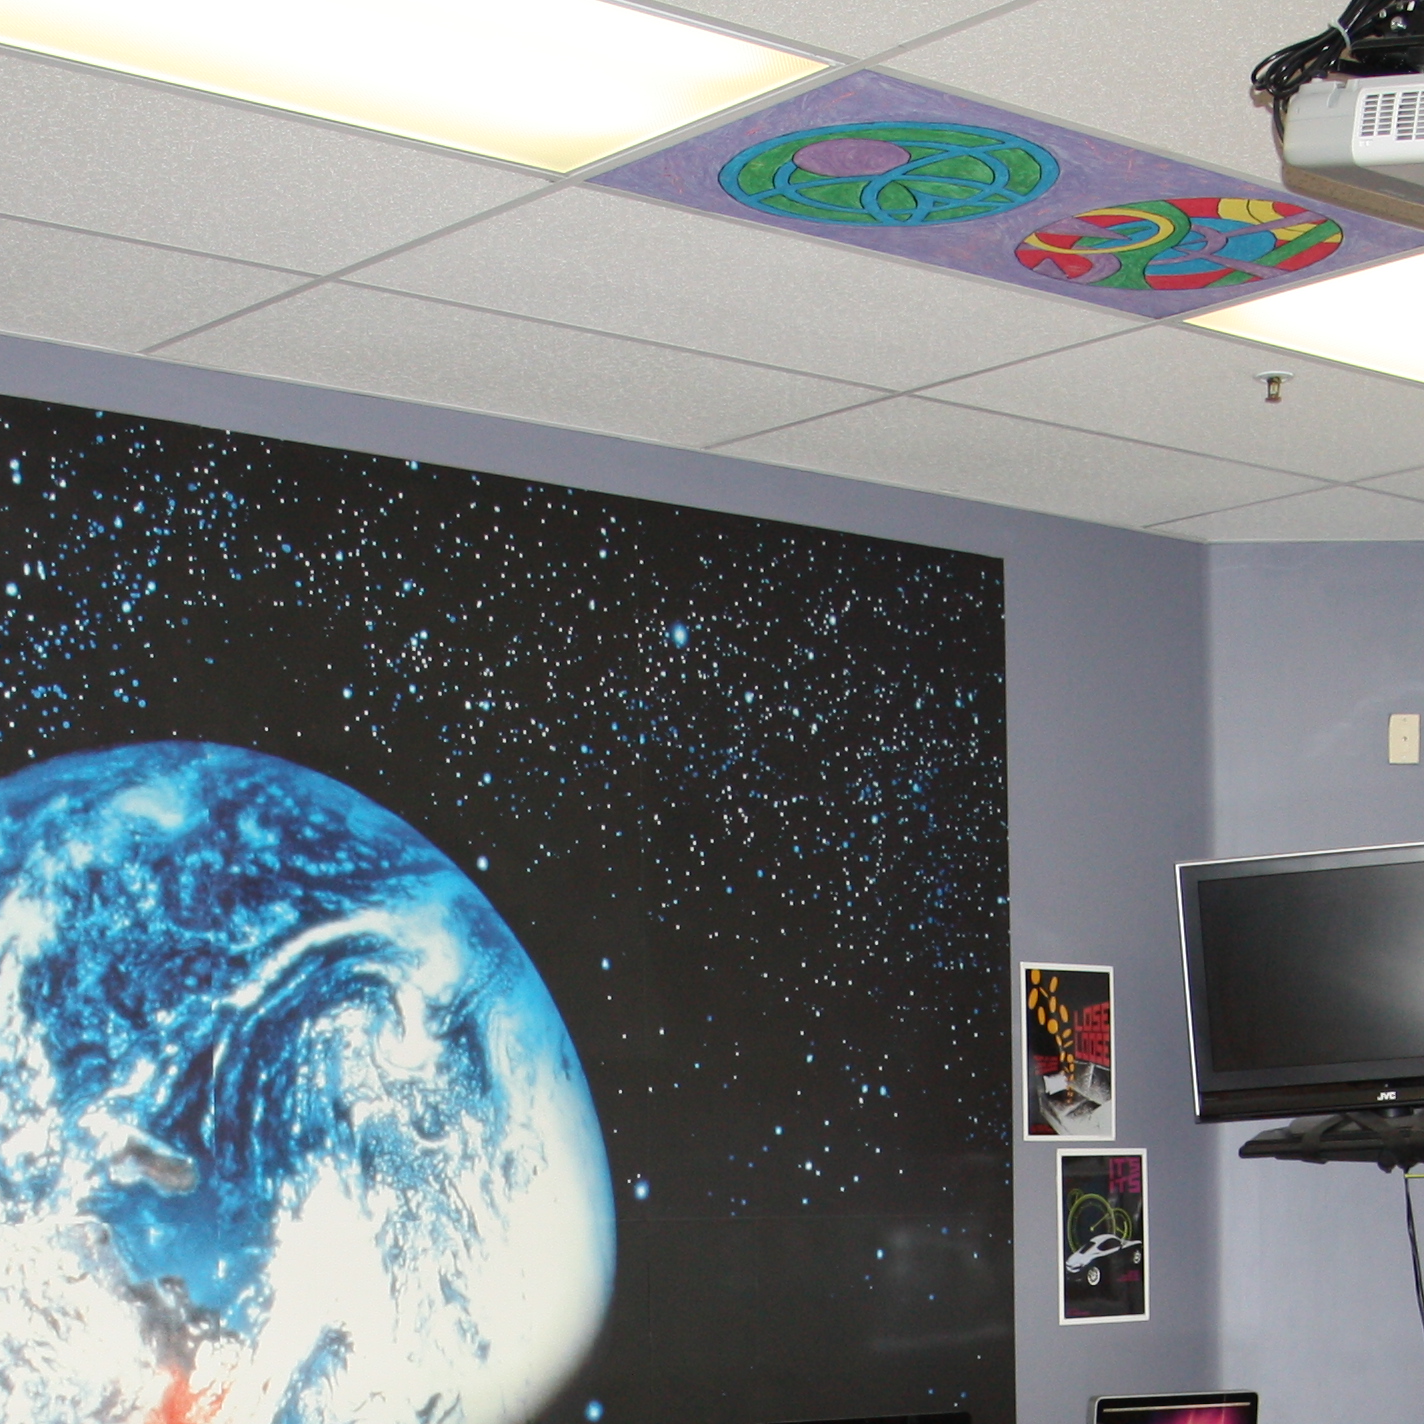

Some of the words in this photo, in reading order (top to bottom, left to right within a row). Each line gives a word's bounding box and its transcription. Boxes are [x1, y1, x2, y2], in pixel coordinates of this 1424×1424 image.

[1074, 1002, 1109, 1031] LOSE
[1074, 1031, 1110, 1067] LOOSE
[1376, 1092, 1396, 1101] JVC
